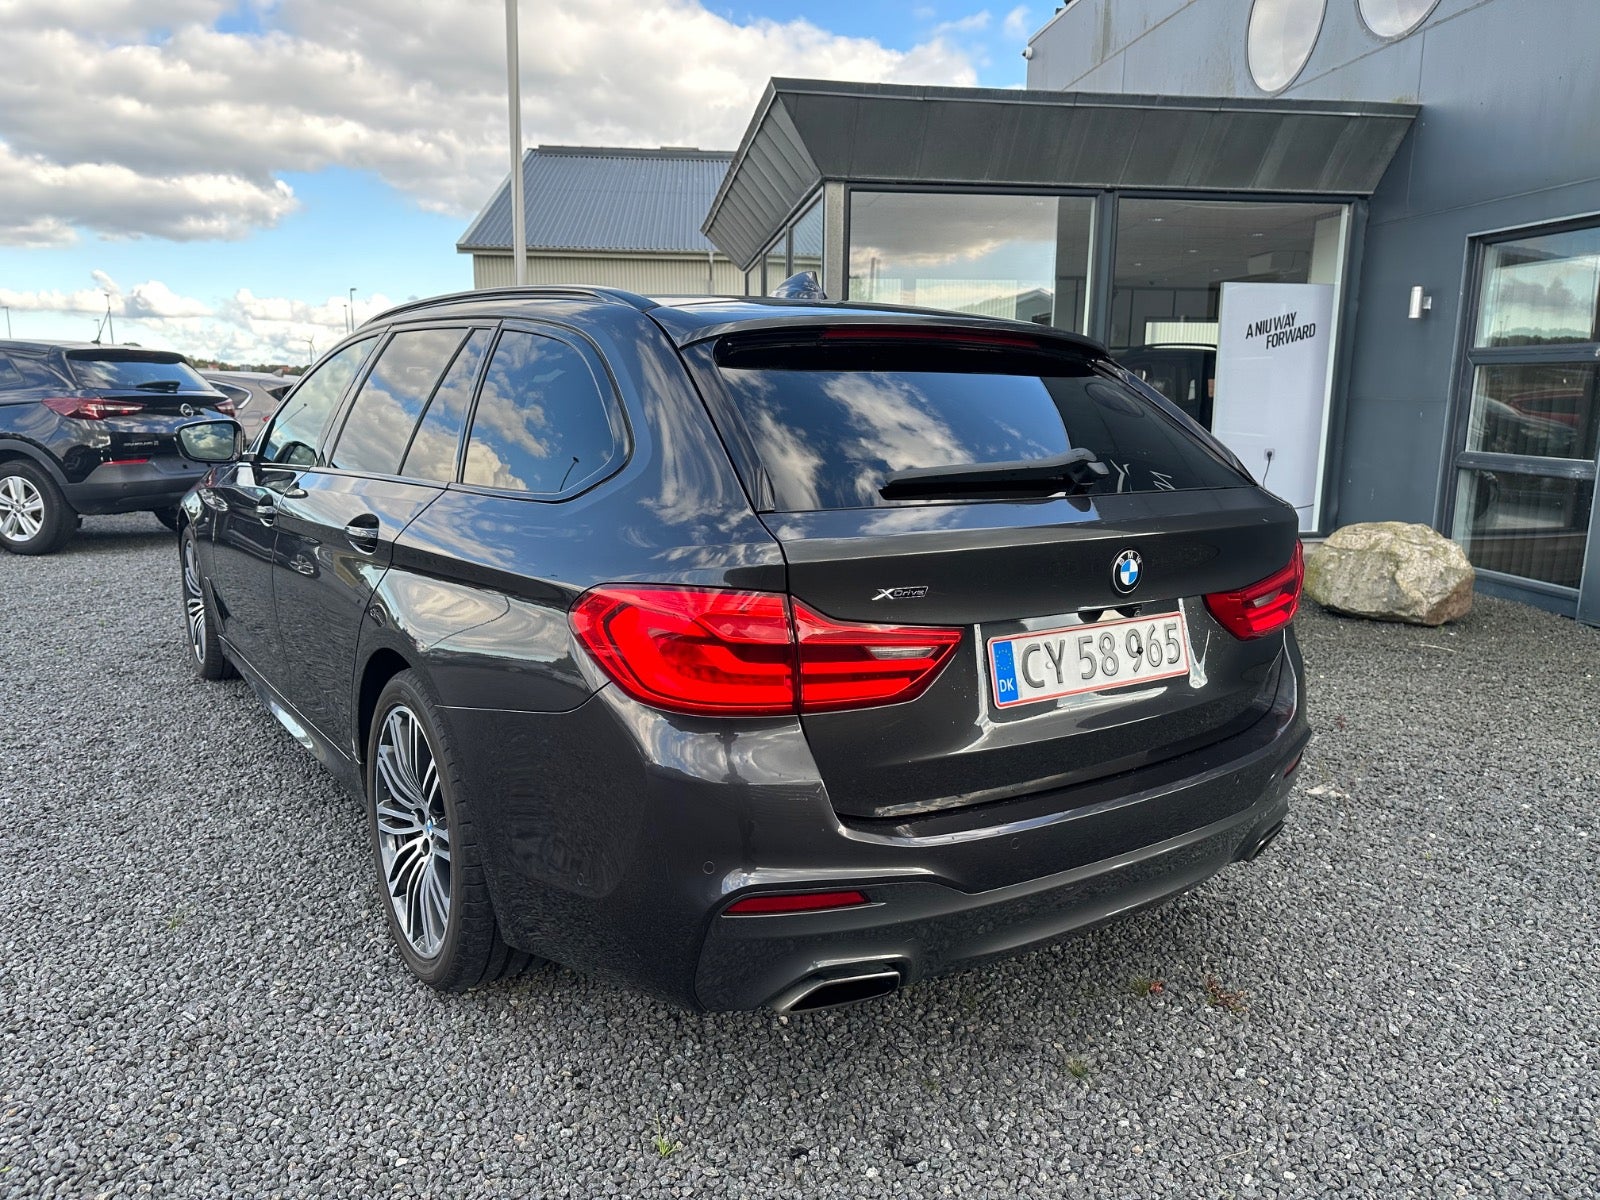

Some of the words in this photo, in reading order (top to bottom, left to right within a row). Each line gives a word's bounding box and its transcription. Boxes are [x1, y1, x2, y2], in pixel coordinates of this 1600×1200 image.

[1245, 323, 1254, 340] A
[1255, 318, 1273, 337] NIU
[1273, 311, 1297, 331] WAY
[1266, 323, 1316, 350] FORWARD
[1021, 639, 1066, 688] CY
[1077, 633, 1119, 680] 58
[1125, 622, 1180, 673] 965
[999, 677, 1015, 693] DK
